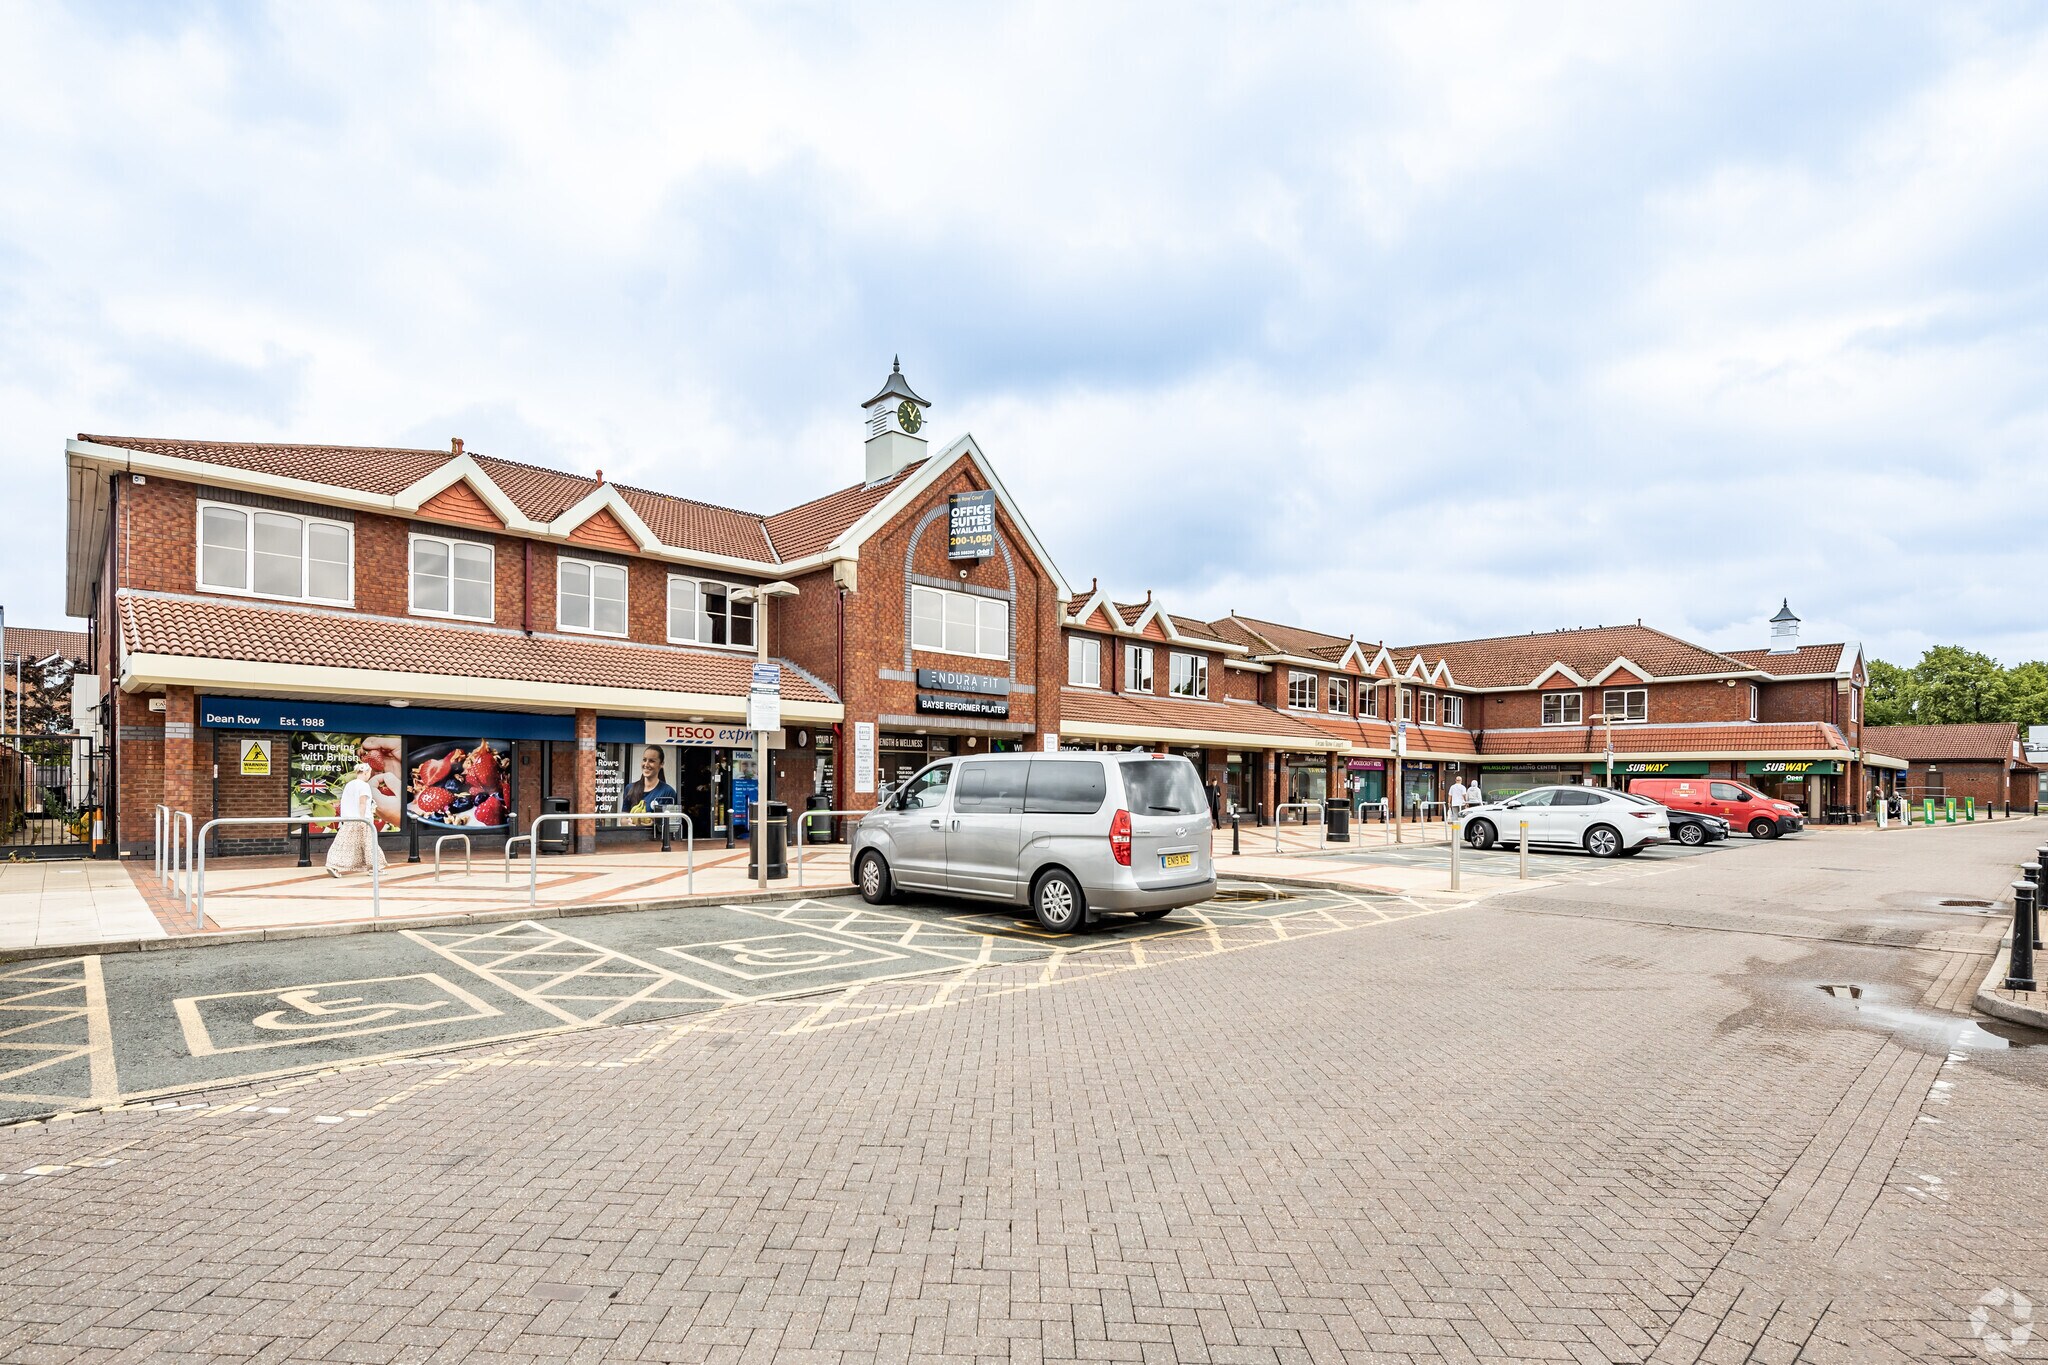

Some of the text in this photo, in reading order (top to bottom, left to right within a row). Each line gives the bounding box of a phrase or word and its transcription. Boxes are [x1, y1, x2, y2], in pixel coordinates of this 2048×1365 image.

[951, 504, 992, 518] OFFICE
[951, 514, 991, 528] SUITES
[950, 525, 992, 536] AVAILABLE
[950, 534, 992, 545] 200-1,050
[931, 672, 998, 688] ENDURA FIT
[922, 700, 1006, 714] BAYSE REFORMER PILATES
[206, 714, 324, 727] Dean Row Est. 1988
[666, 726, 770, 744] TESCO expr
[816, 736, 829, 744] YOUR
[302, 742, 354, 754] Partnering
[880, 737, 894, 746] ENGTH
[900, 738, 923, 748] WELLNESS
[301, 752, 359, 762] with British
[301, 763, 342, 772] farmers
[1626, 764, 1669, 772] SUBWAY
[1762, 762, 1813, 772] SUBWAY
[600, 804, 612, 812] day
